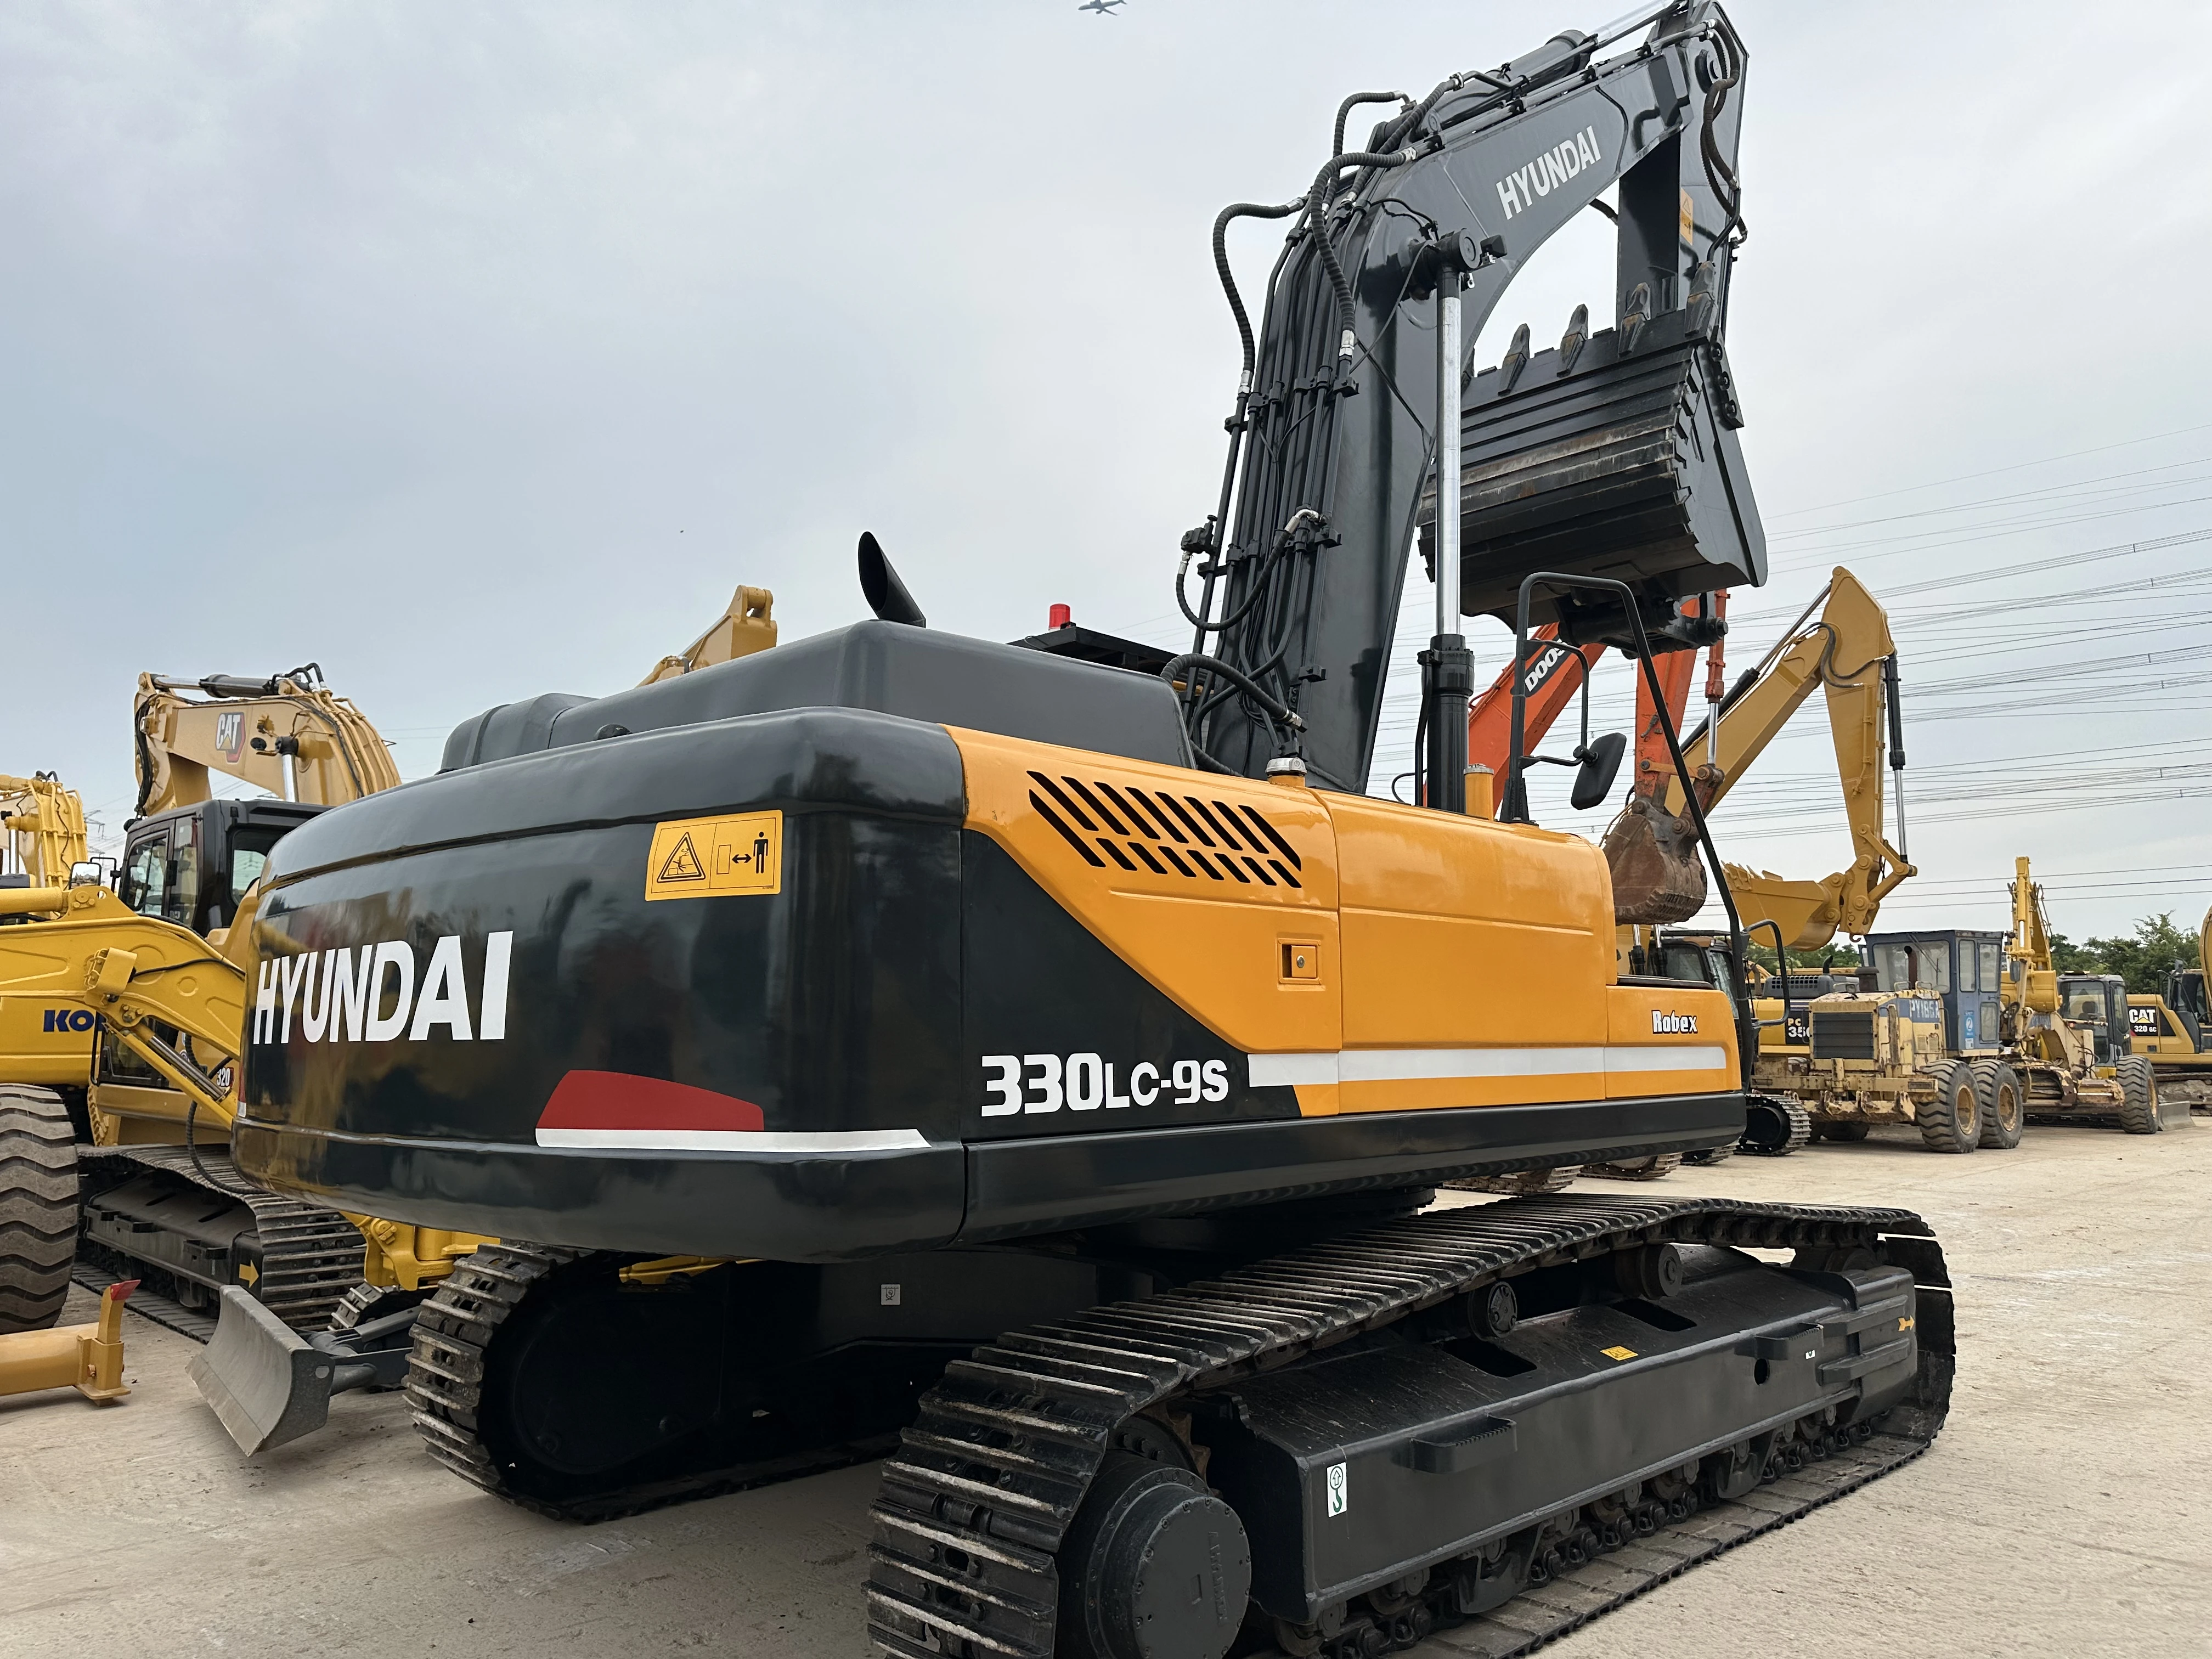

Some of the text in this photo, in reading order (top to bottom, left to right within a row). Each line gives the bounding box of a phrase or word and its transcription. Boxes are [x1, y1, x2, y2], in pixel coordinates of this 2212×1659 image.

[1496, 126, 1601, 220] HYUNDAI
[216, 714, 240, 749] CAT
[253, 931, 513, 1045] HYUNDAI
[1651, 1010, 1698, 1034] Robex
[1787, 1018, 1801, 1026] PC
[2129, 1009, 2155, 1024] CAT
[217, 1067, 230, 1086] 320
[981, 1052, 1229, 1117] 330LC-9S
